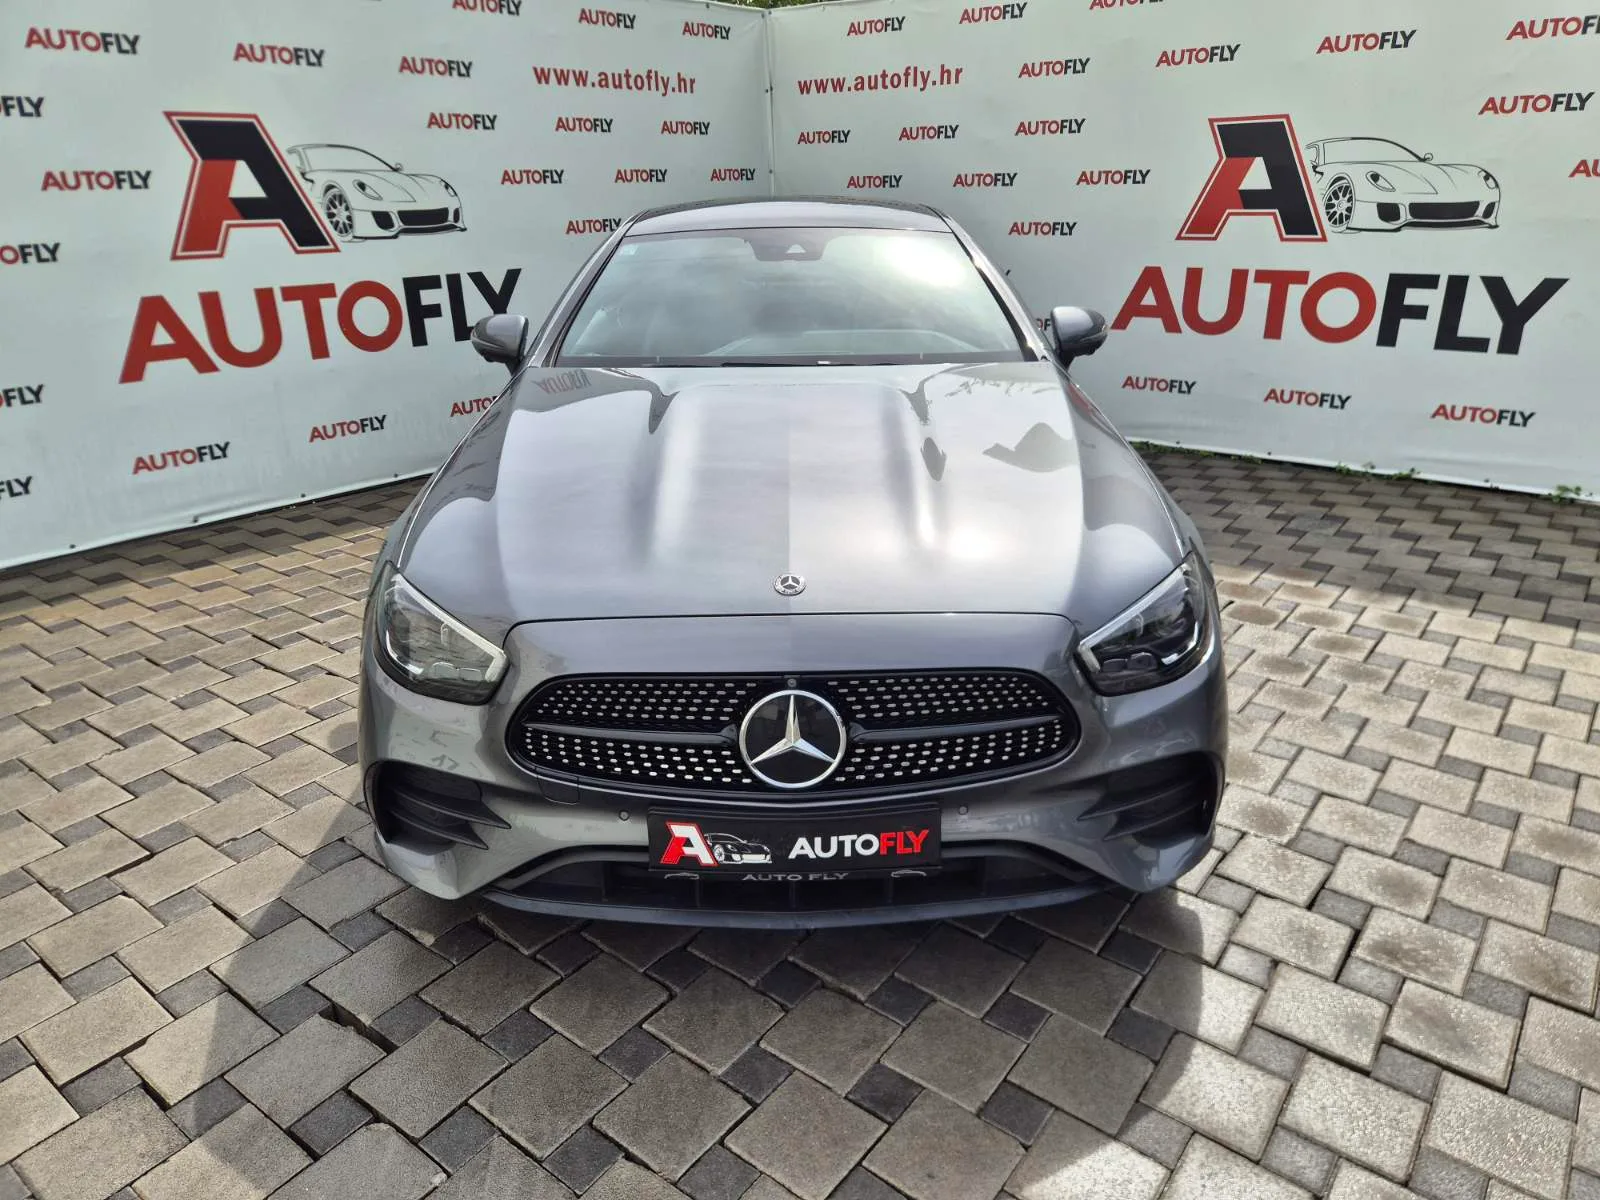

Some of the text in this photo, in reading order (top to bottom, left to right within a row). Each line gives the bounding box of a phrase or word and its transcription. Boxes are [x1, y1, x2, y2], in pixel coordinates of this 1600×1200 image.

[579, 8, 636, 29] AUTOFLY
[959, 2, 1027, 24] AUTOFLY
[683, 21, 730, 40] AUTOFLY
[847, 16, 905, 36] AUTOFLY
[25, 27, 140, 55] AUTOFLY
[1316, 30, 1416, 54] AUTOFLY
[233, 43, 324, 67] AUTOFLY
[1156, 44, 1241, 67] AUTOFLY
[399, 56, 473, 78] AUTOFLY
[1018, 58, 1090, 78] AUTOFLY
[533, 66, 696, 97] www.autofly.hr
[798, 64, 963, 95] www.autofly.hr
[0, 96, 44, 117] FLY
[1478, 92, 1595, 115] AUTOFLY
[427, 112, 497, 130] AUTOFLY
[555, 117, 613, 133] AUTOFLY
[661, 121, 710, 135] AUTOFLY
[1015, 118, 1086, 136] AUTOFLY
[798, 129, 850, 144] AUTOFLY
[899, 125, 959, 141] AUTOFLY
[41, 170, 151, 191] AUTOFLY
[501, 169, 564, 185] AUTOFLY
[615, 169, 667, 183] AUTOFLY
[711, 168, 756, 182] AUTOFLY
[847, 174, 903, 188] AUTOFLY
[953, 173, 1017, 187] AUTOFLY
[1076, 169, 1150, 185] AUTOFLY
[1008, 222, 1077, 236] AUTOFLY
[1111, 266, 1570, 355] AUTOFLY
[118, 268, 522, 384] AUTOFLY
[0, 384, 44, 408] FLY
[1122, 376, 1196, 395] AUTOFLY
[450, 396, 499, 417] AUTO
[1264, 388, 1351, 410] AUTOFLY
[1431, 404, 1536, 428] AUTOFLY
[309, 415, 387, 443] AUTOFLY
[133, 441, 230, 475] AUTOFLY
[788, 829, 929, 860] AUTOFLY
[742, 872, 848, 881] AUTO FLY
